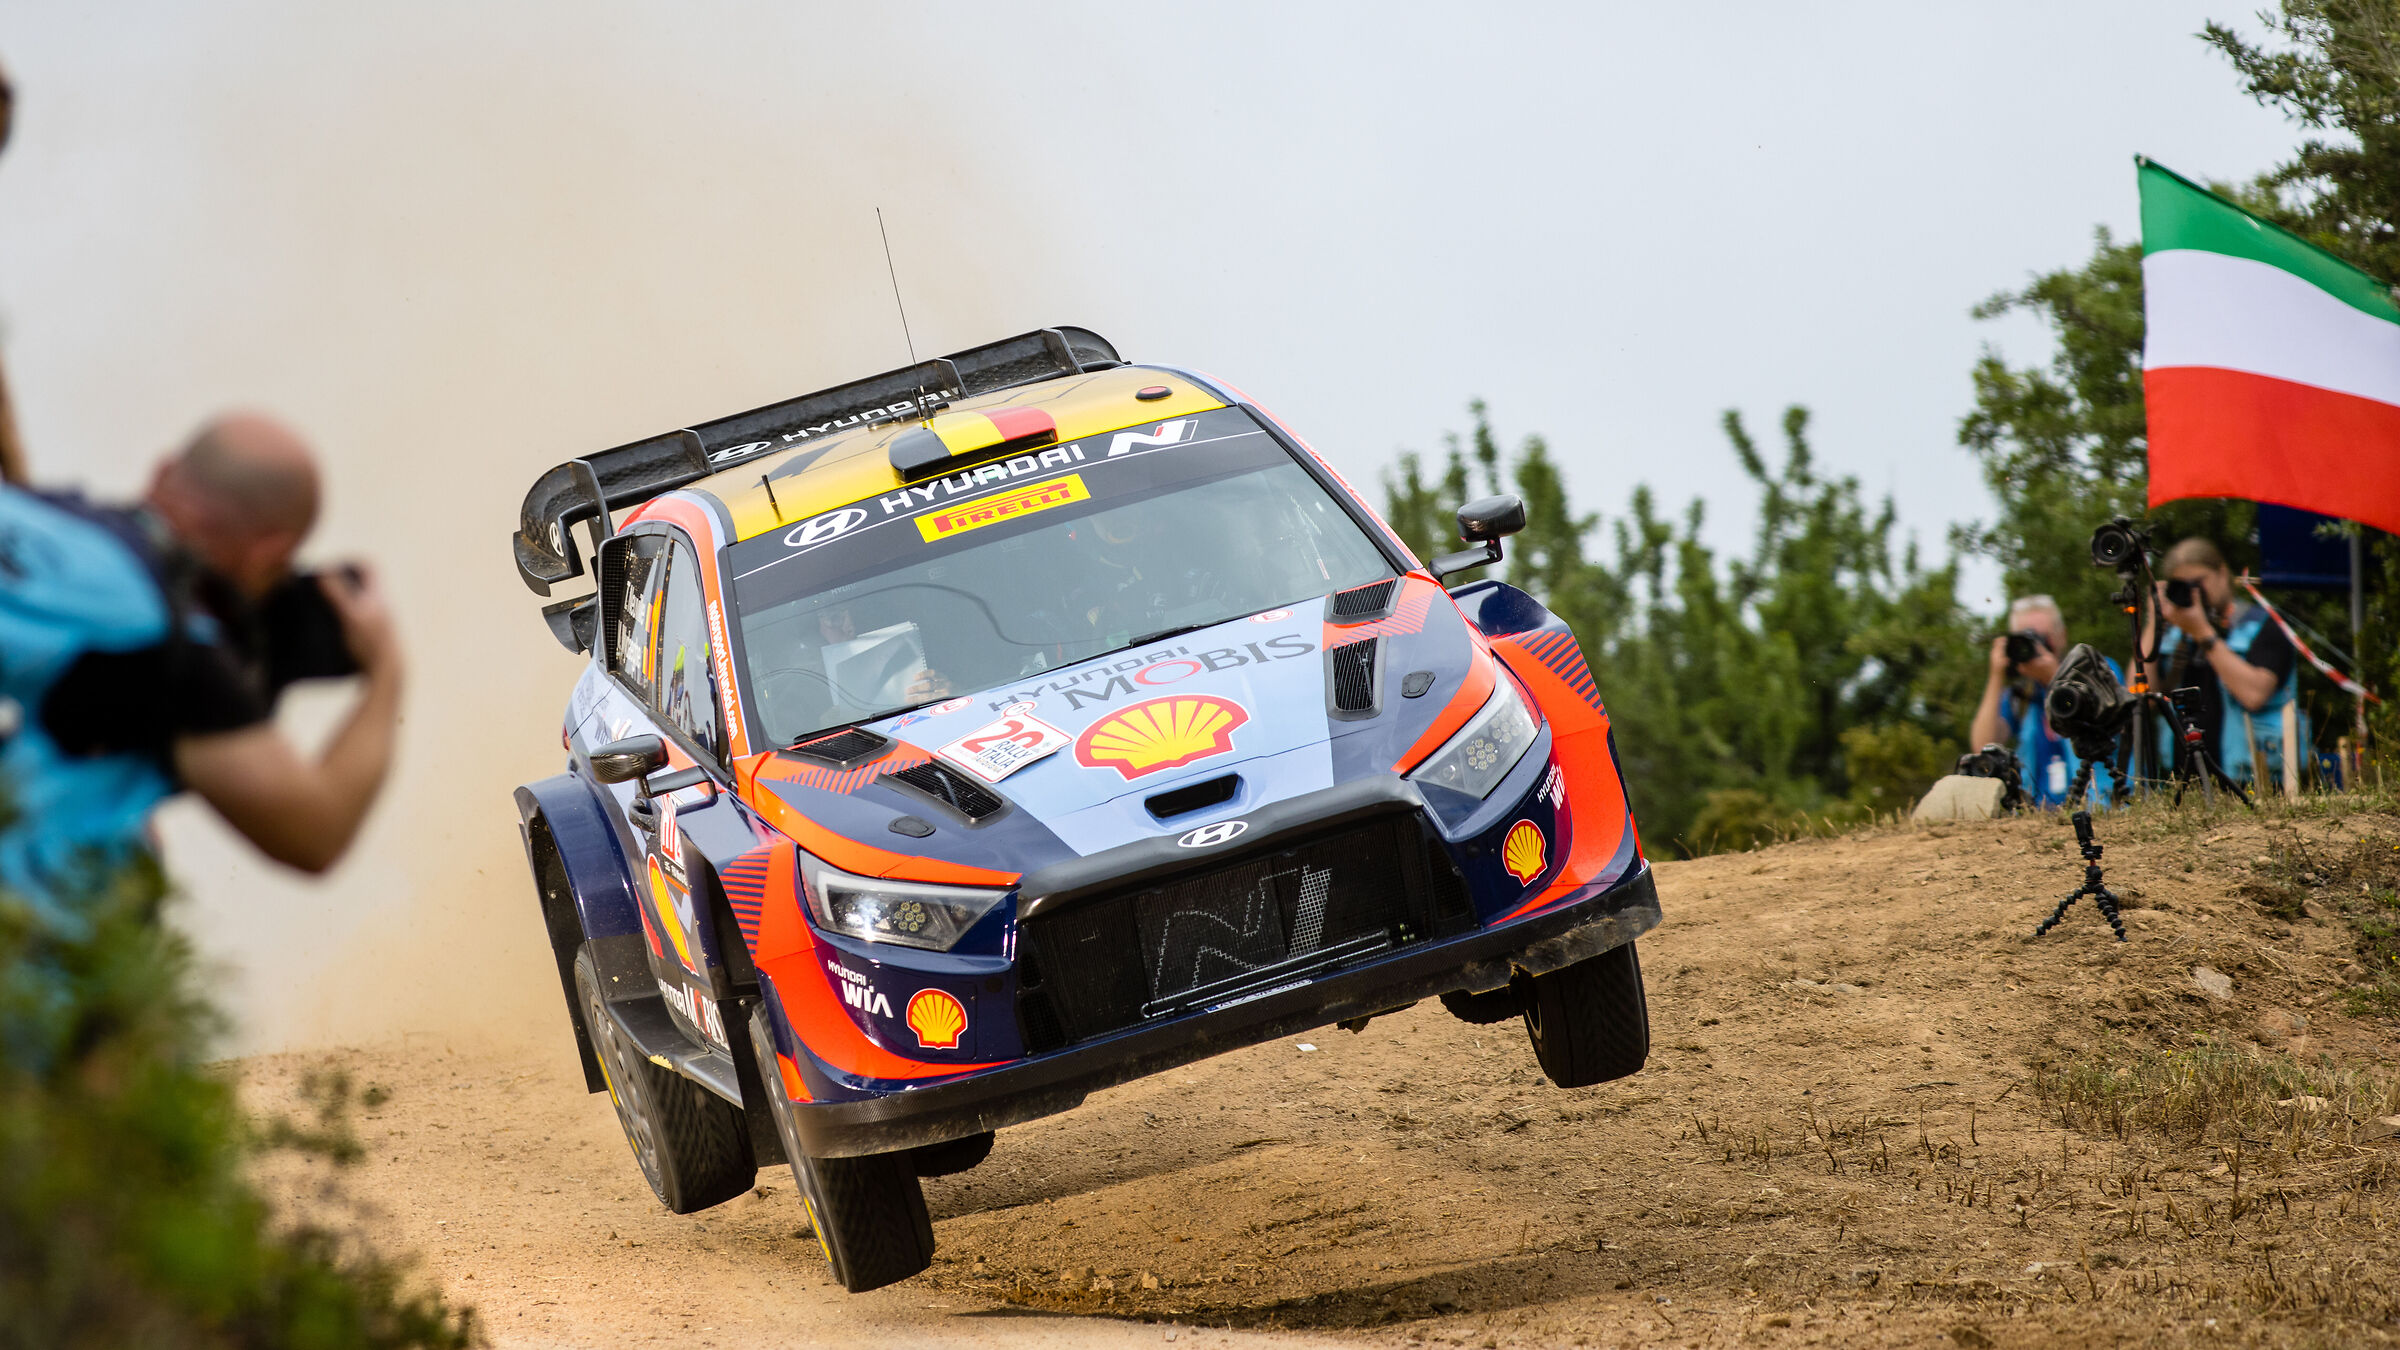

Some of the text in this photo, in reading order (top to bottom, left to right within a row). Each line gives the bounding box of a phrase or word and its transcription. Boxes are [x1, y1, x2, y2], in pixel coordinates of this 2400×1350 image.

[880, 444, 1086, 515] HYUNDAI
[933, 482, 1070, 533] PIRELLI
[989, 646, 1189, 712] HYUNDAI
[1062, 633, 1316, 711] MOBIS
[975, 750, 1016, 769] ITALIA
[994, 740, 1034, 760] RALLY
[828, 959, 867, 986] HYUNDAI
